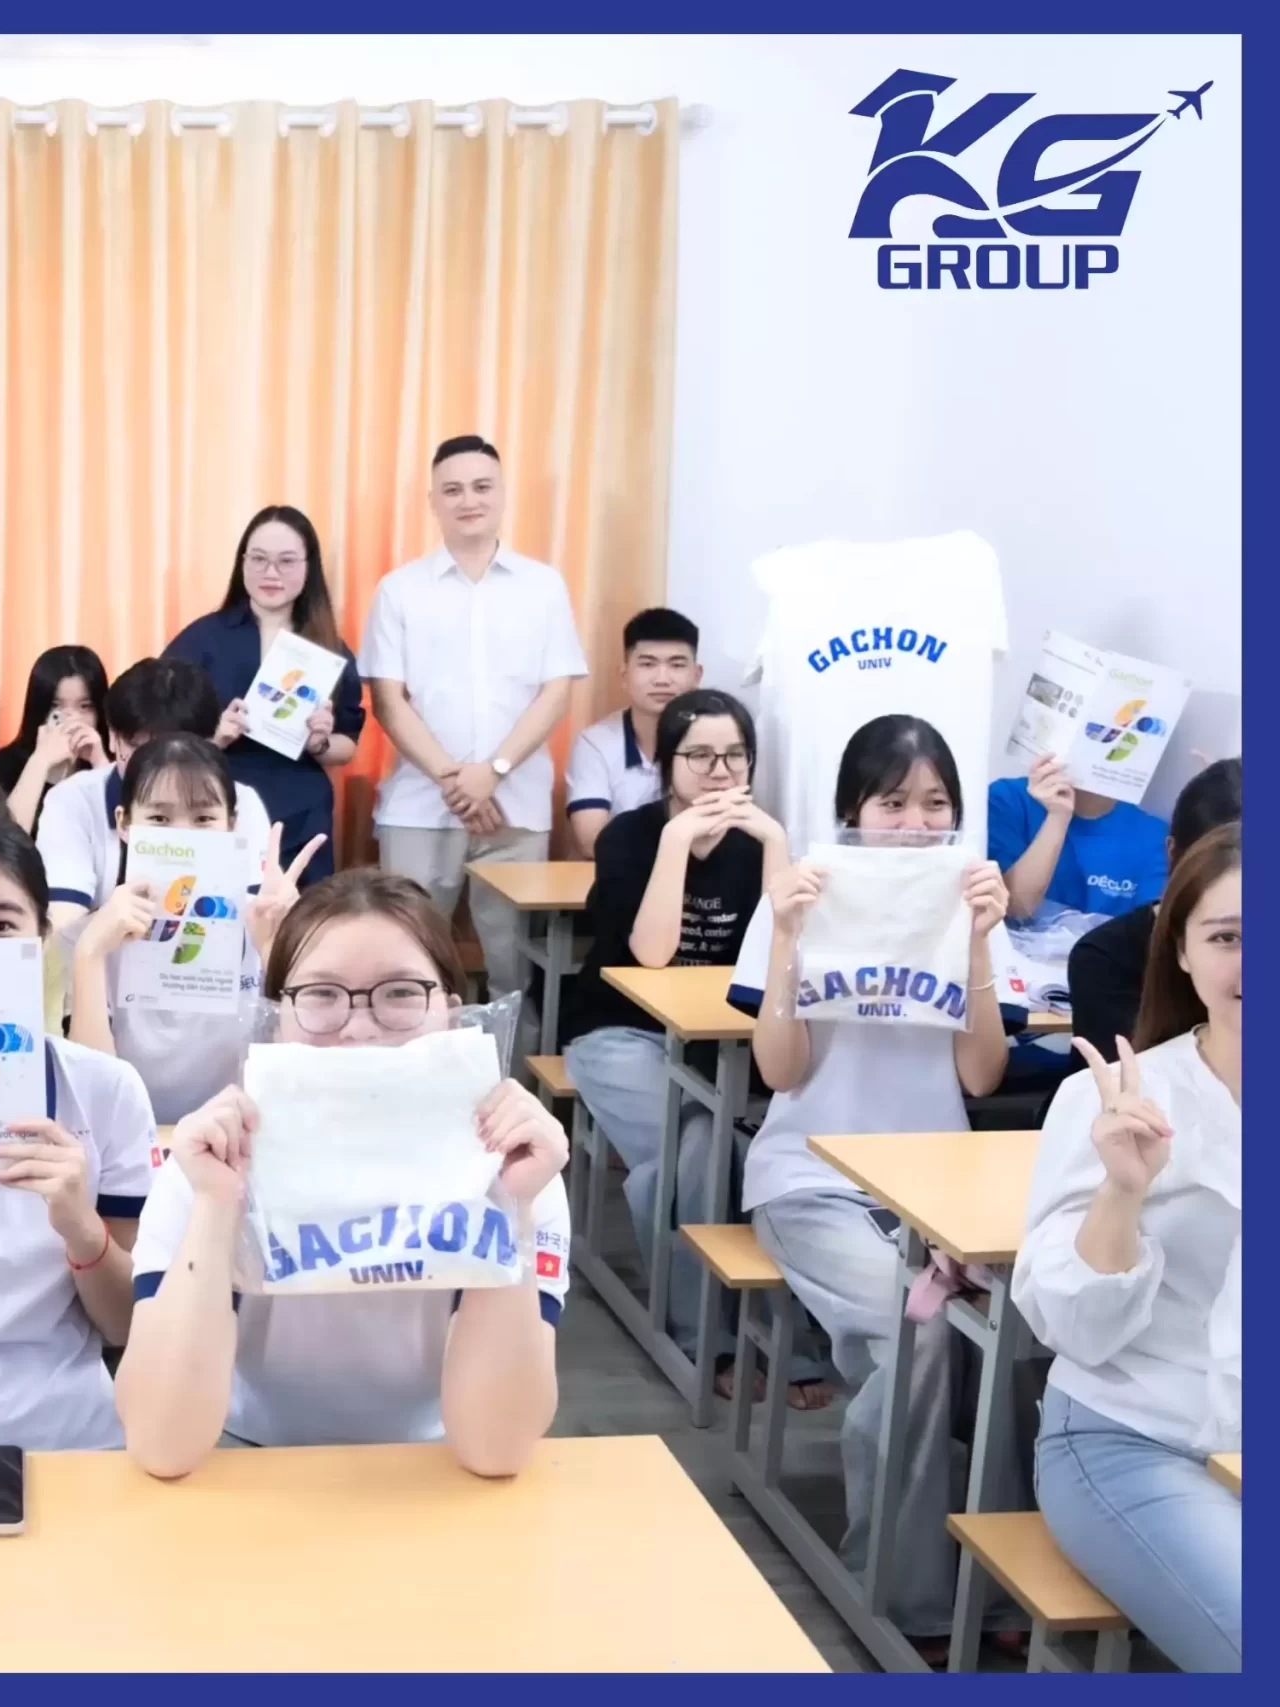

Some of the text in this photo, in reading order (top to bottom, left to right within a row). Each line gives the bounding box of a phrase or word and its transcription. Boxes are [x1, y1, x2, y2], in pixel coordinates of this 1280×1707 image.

[807, 626, 948, 673] GACHON
[857, 657, 892, 670] UNIV
[134, 840, 195, 858] Gachon
[797, 966, 966, 1020] GACHON
[857, 1003, 908, 1017] UNIV.
[349, 1260, 433, 1284] UNIV.
